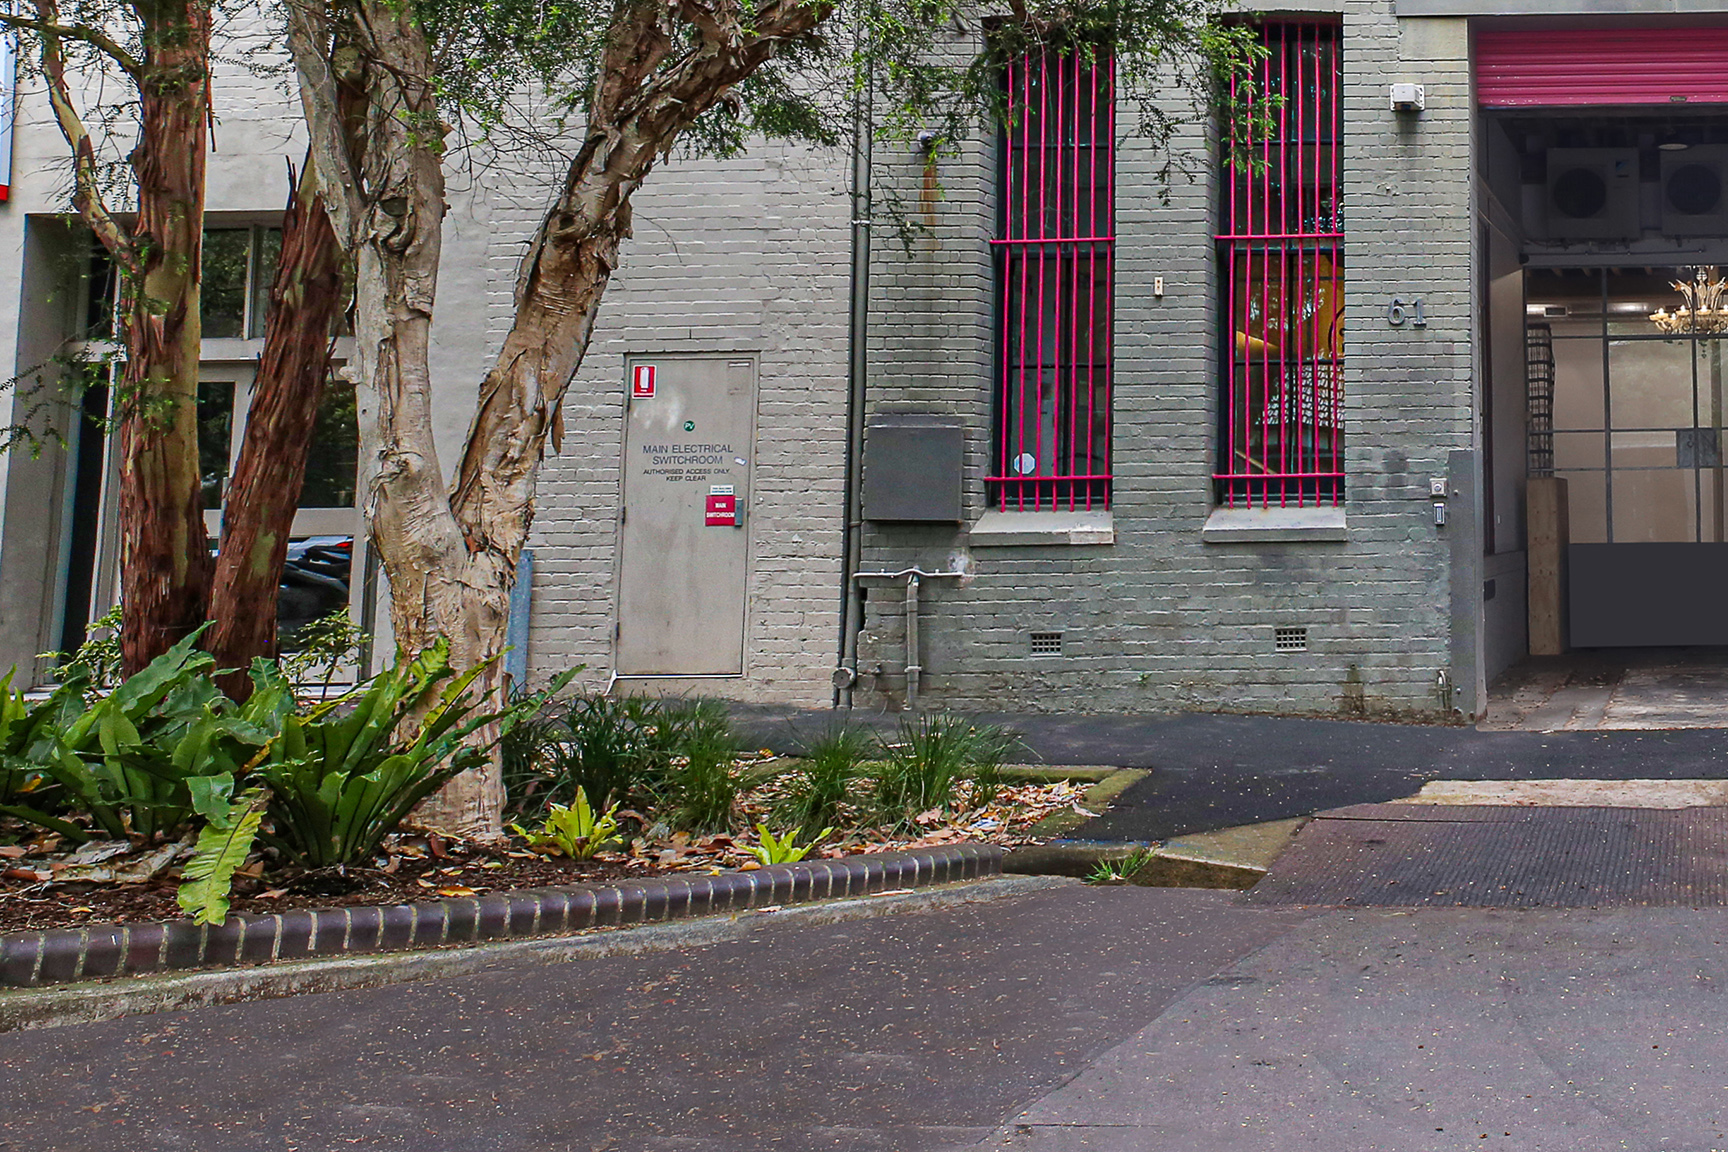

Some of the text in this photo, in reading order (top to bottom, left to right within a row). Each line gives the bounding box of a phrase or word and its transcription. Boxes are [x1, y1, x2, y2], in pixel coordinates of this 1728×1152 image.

[1387, 297, 1427, 328] 61
[642, 443, 734, 454] MAIN ELECTRICAL
[652, 455, 723, 466] SWITCHROOM
[713, 467, 731, 475] ONLY
